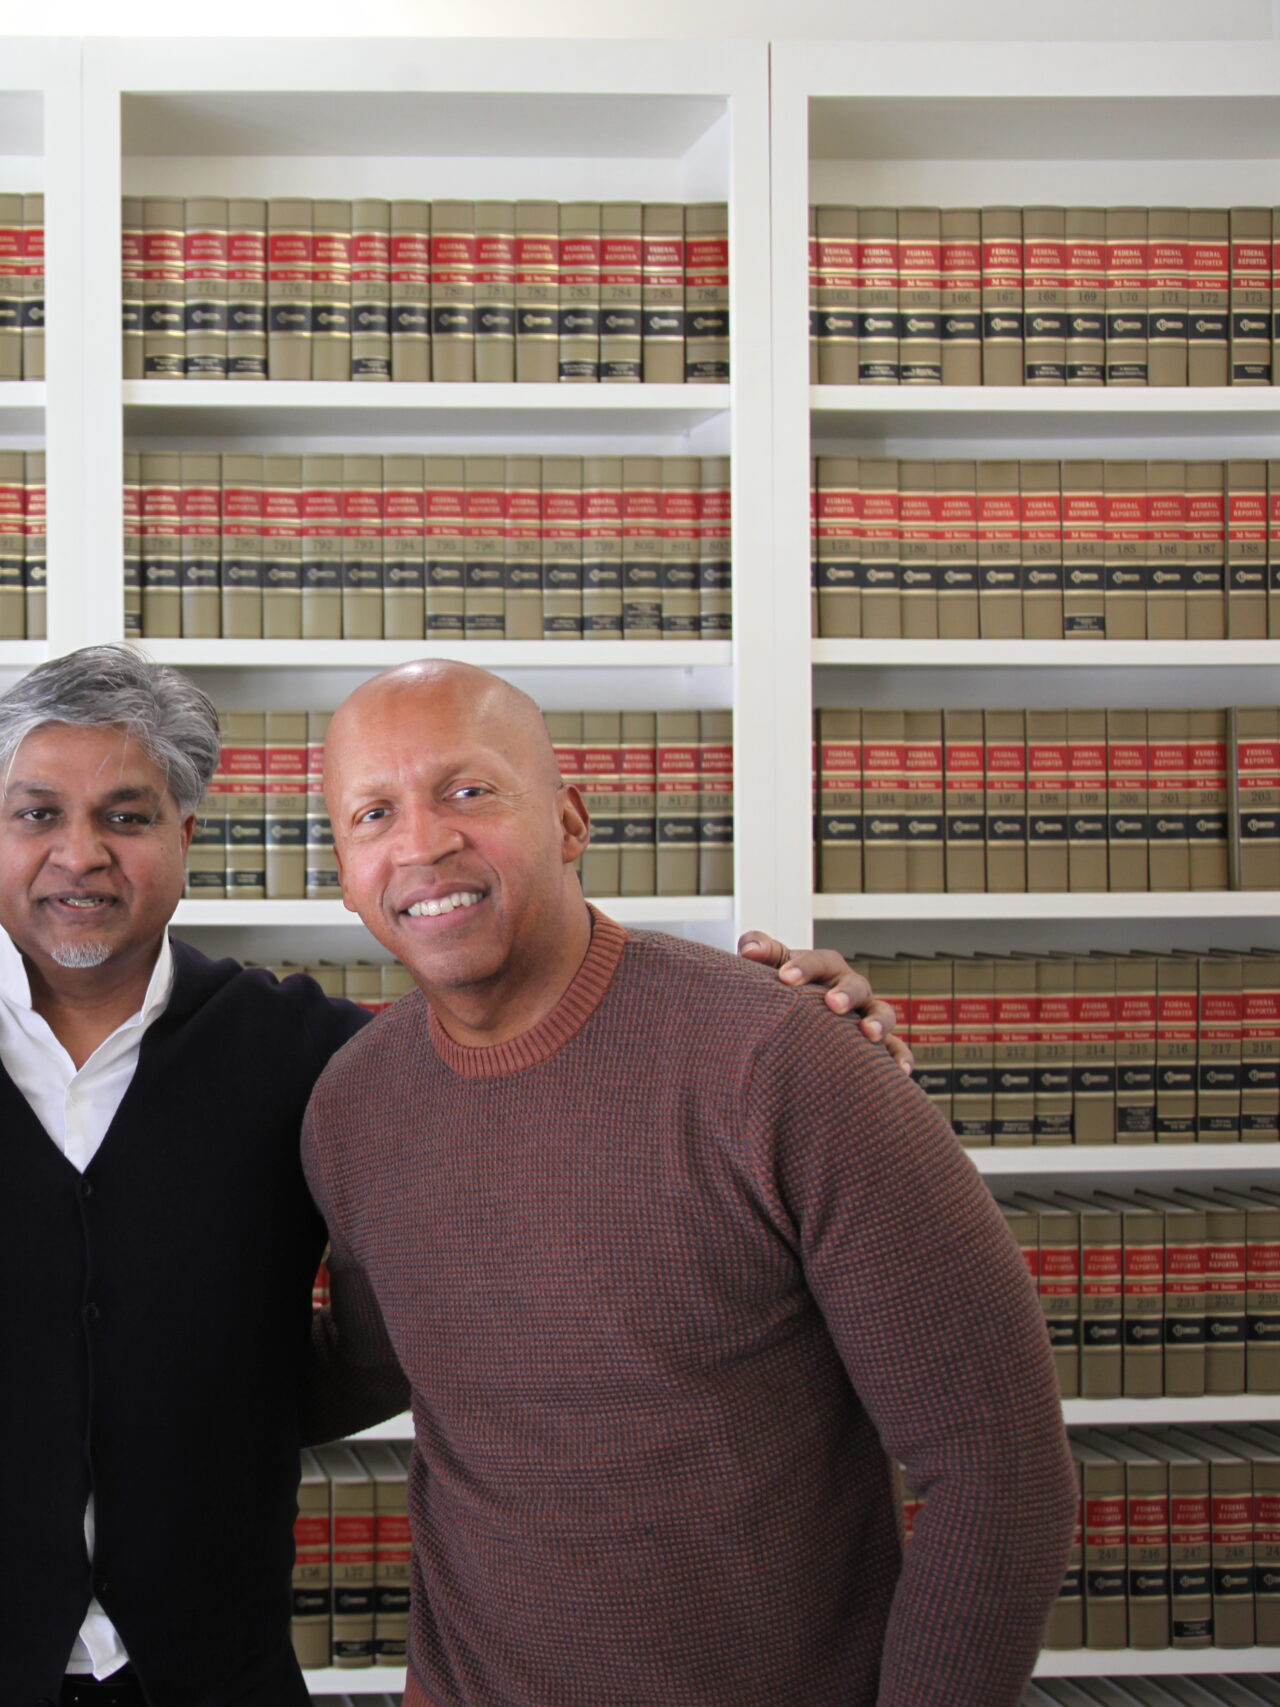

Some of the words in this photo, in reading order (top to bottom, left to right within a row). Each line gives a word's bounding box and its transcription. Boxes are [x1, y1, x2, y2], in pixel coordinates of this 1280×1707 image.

[864, 248, 891, 256] FEDERAL
[906, 249, 933, 257] FEDERAL
[991, 248, 1017, 256] FEDERAL
[1156, 249, 1181, 257] FEDERAL
[1239, 249, 1265, 257] FEDERAL
[823, 256, 853, 264] REPORTER
[862, 257, 893, 265] REPORTER
[904, 258, 935, 266] REPORTER
[944, 258, 975, 266] REPORTER
[989, 257, 1019, 265] REPORTER
[1154, 257, 1184, 265] REPORTER
[903, 501, 929, 509] FEDERAL
[943, 501, 970, 509] FEDERAL
[984, 501, 1011, 509] FEDERAL
[1070, 501, 1097, 509] FEDERAL
[1235, 501, 1260, 509] FEDERAL
[901, 509, 931, 517] REPORTER
[941, 509, 972, 517] REPORTER
[1068, 509, 1099, 517] REPORTER
[1233, 509, 1263, 517] REPORTER
